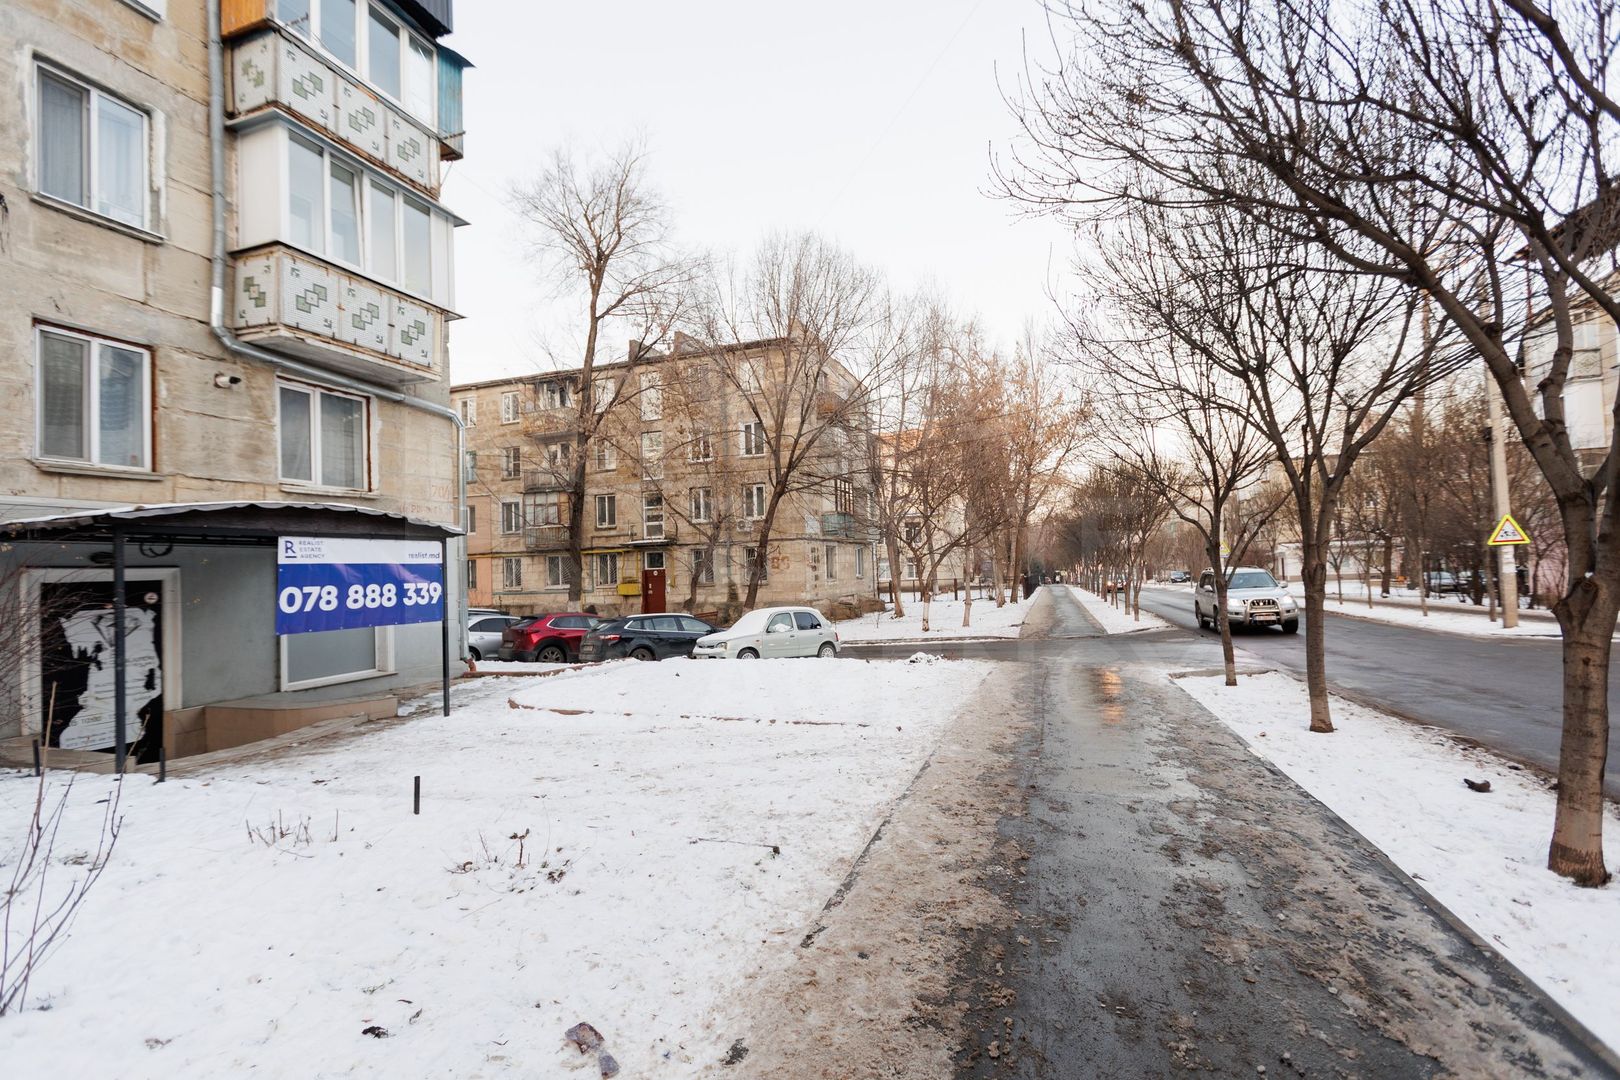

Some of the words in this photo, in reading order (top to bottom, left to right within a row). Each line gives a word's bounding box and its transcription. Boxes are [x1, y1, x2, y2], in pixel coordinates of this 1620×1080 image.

[279, 585, 339, 614] 078
[345, 583, 398, 610] 888
[402, 581, 442, 607] 339
